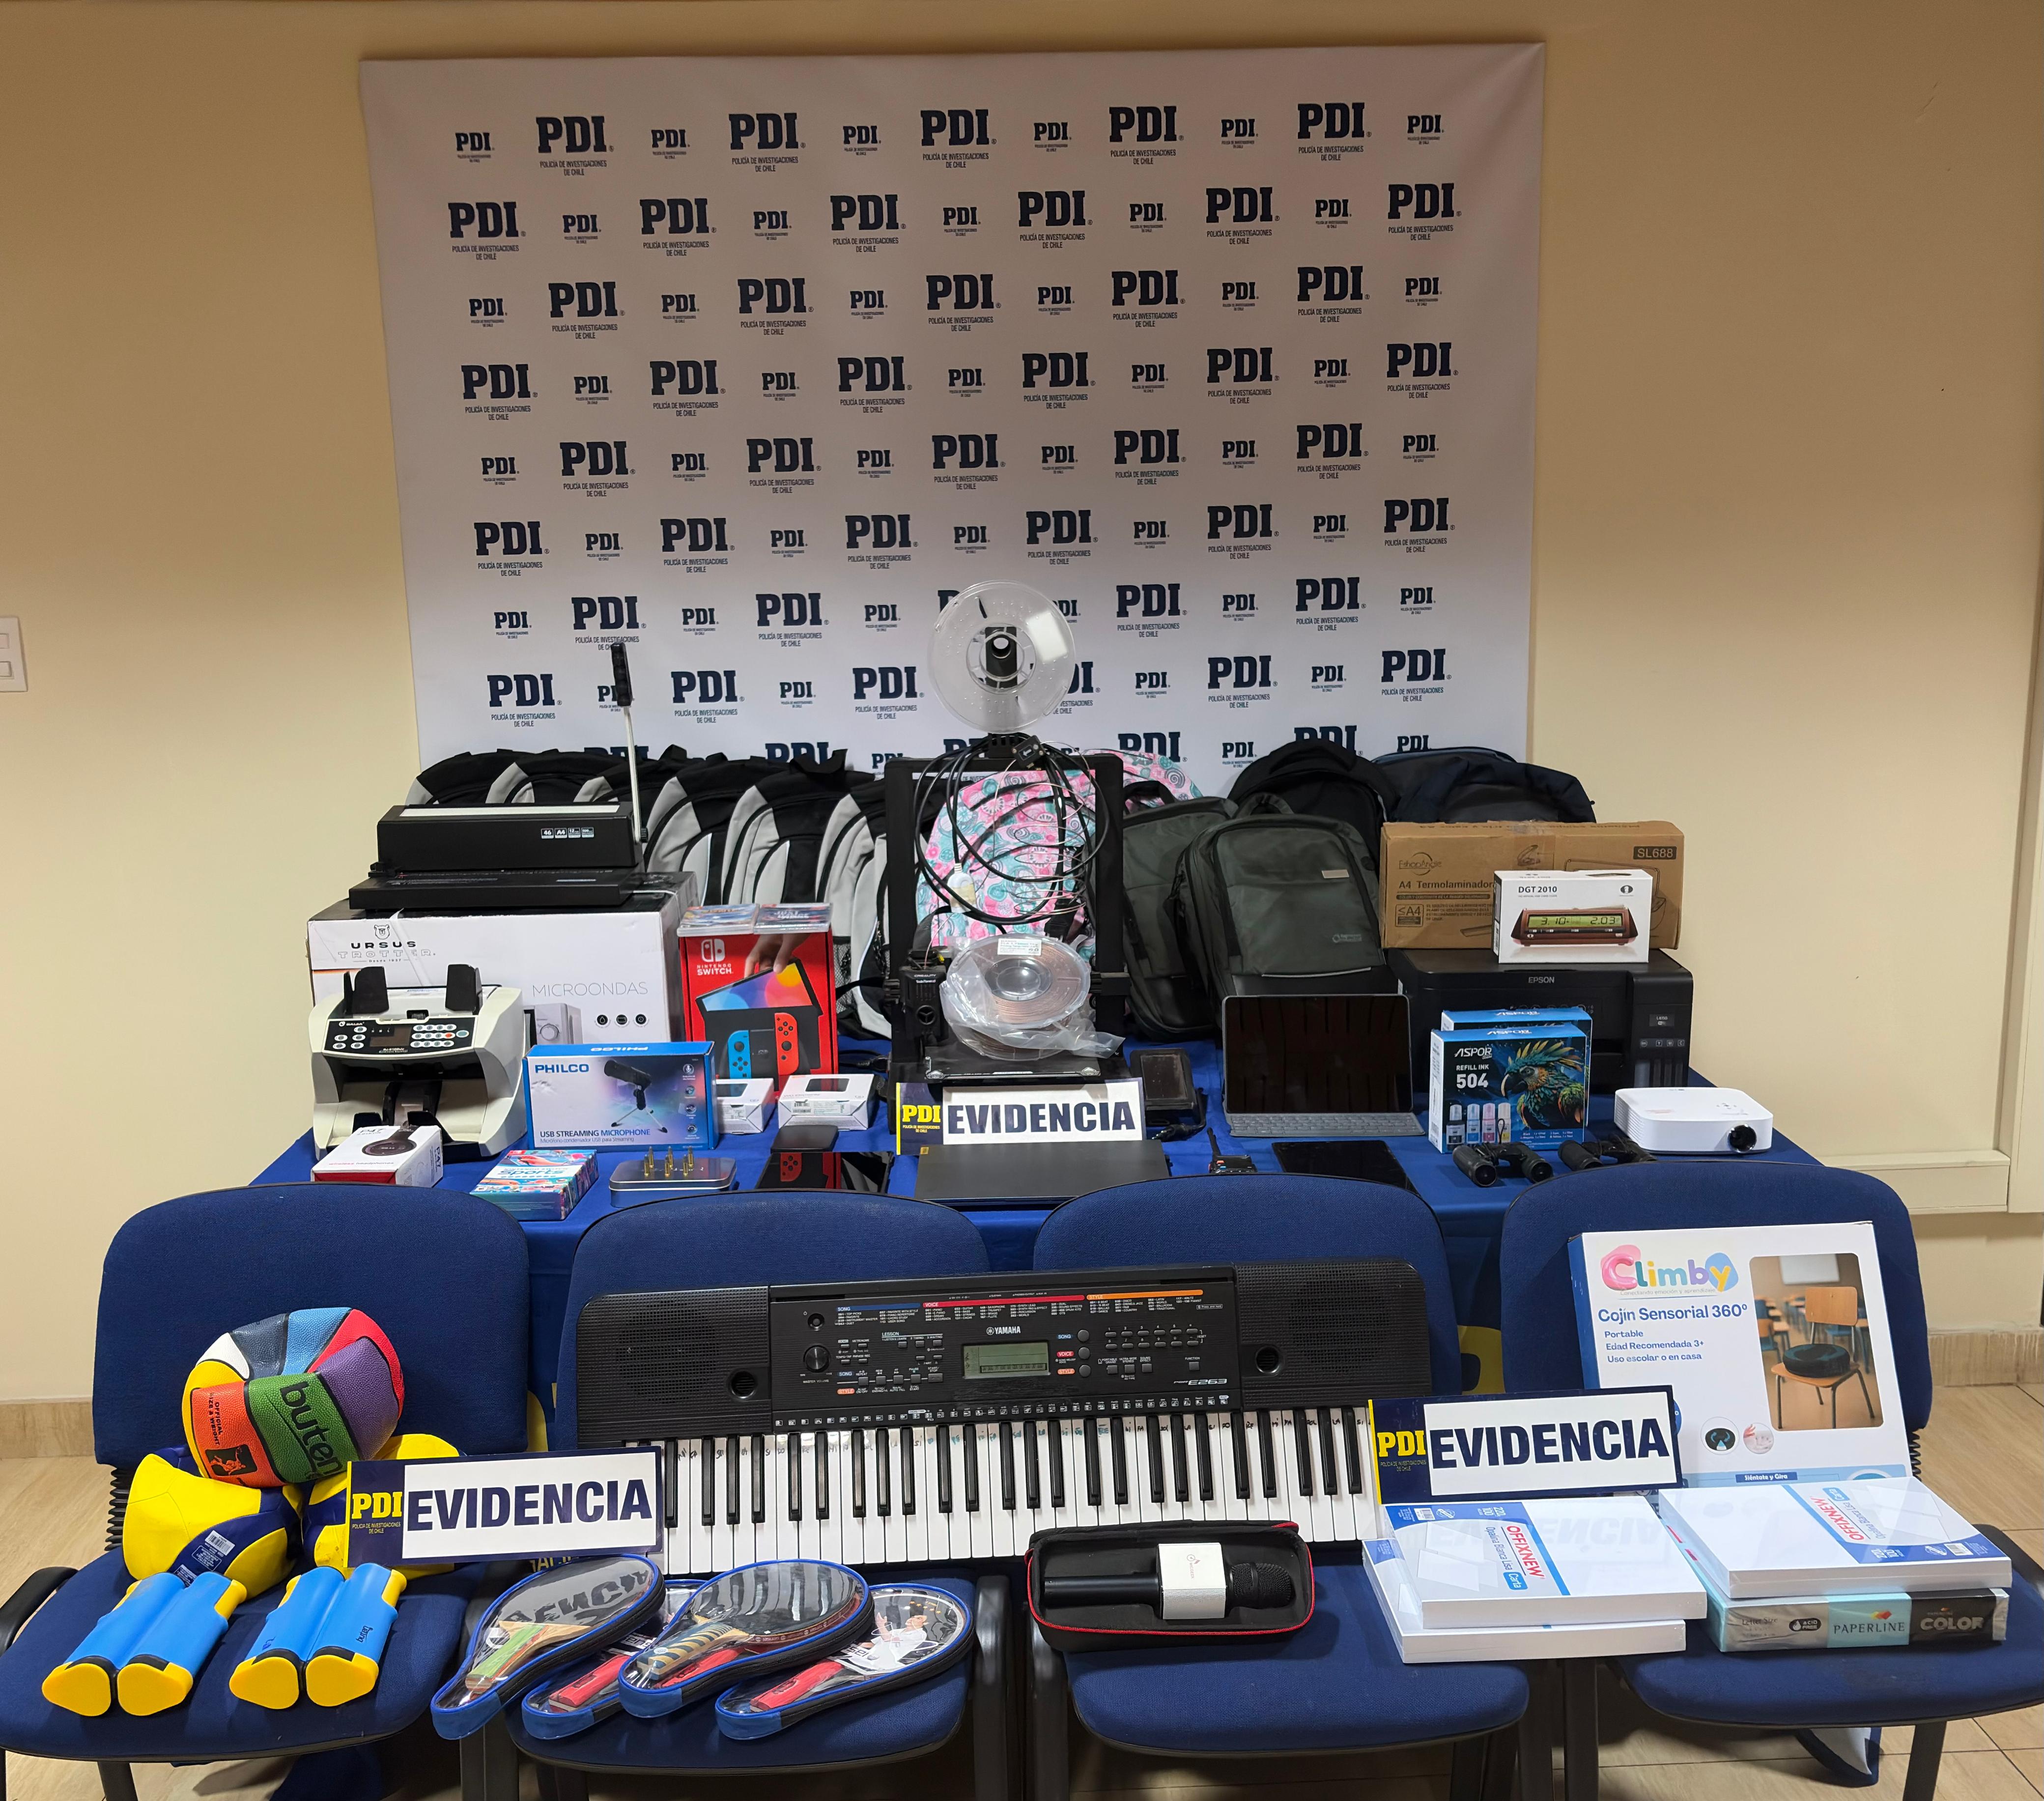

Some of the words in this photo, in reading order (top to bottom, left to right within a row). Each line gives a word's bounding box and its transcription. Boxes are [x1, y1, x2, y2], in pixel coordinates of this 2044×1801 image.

[536, 116, 605, 153] PDI
[729, 113, 797, 150] PDI
[921, 109, 988, 146] PDI
[1034, 122, 1068, 141] PDI
[1109, 106, 1176, 142] PDI
[1298, 102, 1364, 139] PDI
[1408, 115, 1442, 133] PDI
[652, 130, 686, 148] PDI
[640, 199, 708, 234] PDI
[830, 195, 898, 230] PDI
[1018, 191, 1085, 227] PDI
[1206, 187, 1272, 223] PDI
[1315, 200, 1349, 217] PDI
[1388, 183, 1454, 219] PDI
[448, 201, 517, 238] PDI
[738, 278, 805, 314] PDI
[1112, 270, 1178, 306] PDI
[469, 298, 504, 316] PDI
[1207, 347, 1272, 383] PDI
[1387, 343, 1451, 377] PDI
[461, 364, 529, 399] PDI
[650, 360, 717, 395] PDI
[948, 369, 982, 386] PDI
[932, 434, 997, 469] PDI
[1297, 423, 1362, 458] PDI
[1403, 435, 1436, 452] PDI
[560, 441, 627, 476] PDI
[672, 454, 706, 471] PDI
[845, 515, 910, 548] PDI
[1026, 510, 1091, 544] PDI
[1384, 498, 1448, 533] PDI
[474, 521, 541, 555] PDI
[1116, 584, 1180, 617] PDI
[1400, 587, 1433, 604] PDI
[571, 596, 638, 629] PDI
[1208, 656, 1271, 689] PDI
[1381, 649, 1446, 682] PDI
[487, 674, 554, 707] PDI
[671, 670, 737, 703] PDI
[852, 666, 916, 699] PDI
[1637, 848, 1673, 858] SL688
[1399, 881, 1412, 889] A4
[533, 982, 648, 998] MICROONDAS
[535, 1063, 590, 1074] PHILCO
[1454, 1047, 1492, 1058] ASPOR
[1456, 1073, 1489, 1089] 504
[902, 1105, 941, 1123] PDI
[947, 1101, 1136, 1134] EVIDENCIA
[1602, 1253, 1732, 1292] Climby
[1598, 1308, 1636, 1325] Cojín
[1639, 1305, 1708, 1321] Sensorial
[1604, 1330, 1644, 1339] Portable
[1606, 1342, 1628, 1351] Edad
[1629, 1340, 1692, 1350] Recomendada
[1607, 1355, 1625, 1364] Uso
[1626, 1354, 1659, 1363] escolar
[210, 1417, 220, 1446] WEIGHT
[1377, 1430, 1426, 1457] PDI
[1430, 1418, 1670, 1470] EVIDENCIA
[352, 1491, 403, 1519] PDI
[407, 1479, 653, 1532] EVIDENCIA
[1810, 1496, 1864, 1541] OFFIXNEW
[1484, 1527, 1500, 1544] Opalina
[1494, 1544, 1507, 1560] Blanca
[1502, 1560, 1513, 1570] Lisa
[1506, 1526, 1545, 1577] OFFIXNEW
[1508, 1573, 1522, 1589] Carta
[1834, 1621, 1905, 1634] PAPERLINE
[1920, 1616, 1985, 1632] COLOR
